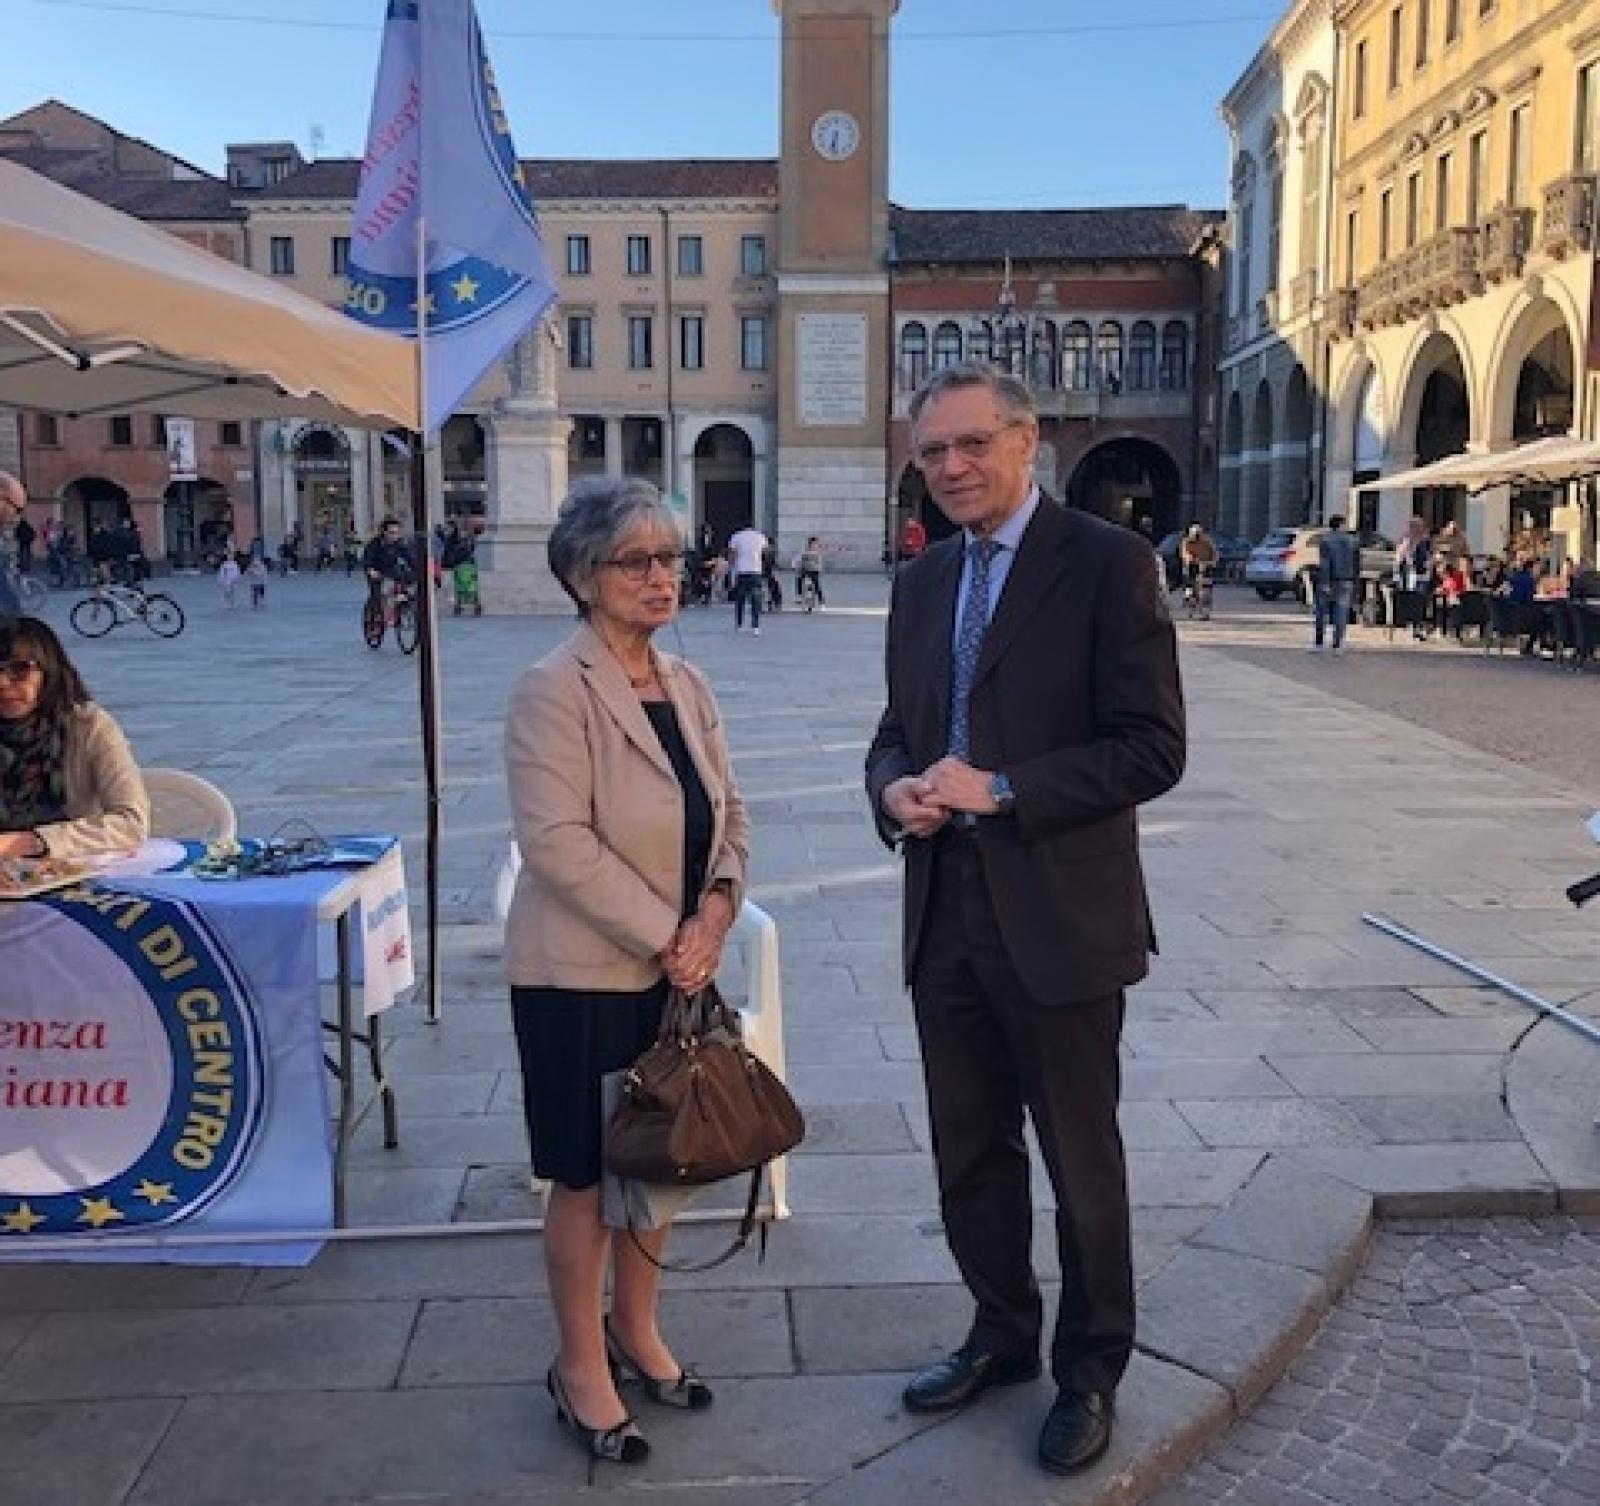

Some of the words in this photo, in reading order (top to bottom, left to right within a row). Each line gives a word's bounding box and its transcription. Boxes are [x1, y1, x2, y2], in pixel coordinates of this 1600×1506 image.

[5, 1064, 130, 1107] iana
[138, 924, 198, 980] DI
[173, 987, 235, 1170] CENTRO
